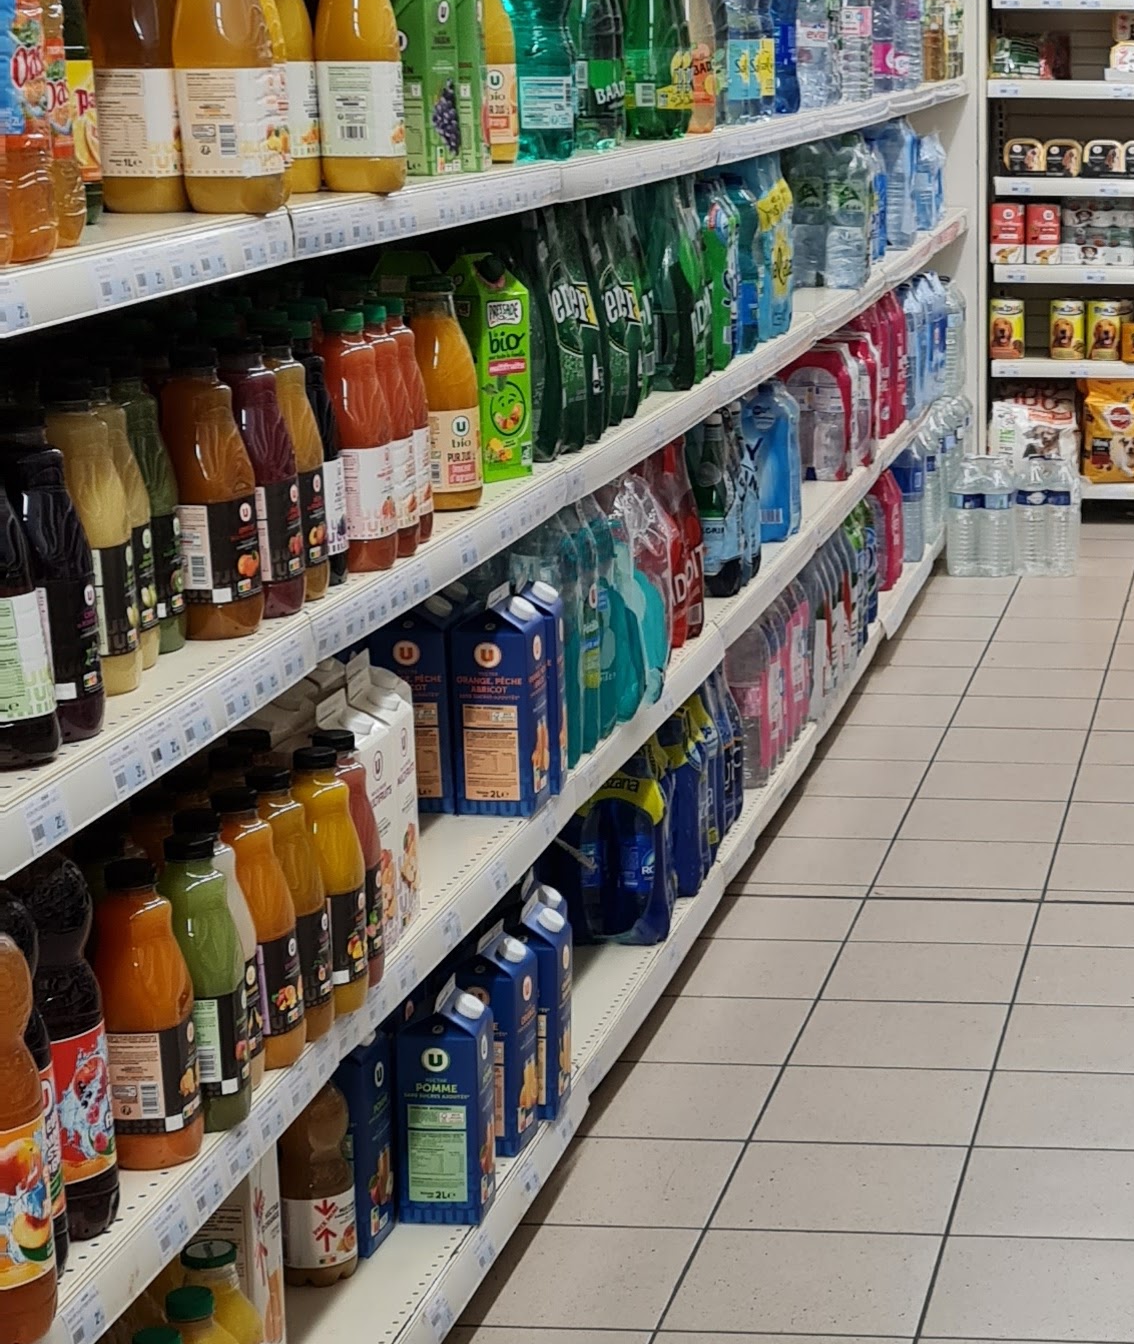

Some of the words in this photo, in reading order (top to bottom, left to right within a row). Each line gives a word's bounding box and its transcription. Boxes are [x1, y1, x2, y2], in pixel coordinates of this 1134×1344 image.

[489, 331, 525, 355] bio
[456, 420, 467, 432] U
[451, 438, 472, 449] bio
[400, 647, 414, 661] U
[480, 649, 494, 663] U
[495, 675, 523, 686] PÊCHE
[471, 685, 509, 695] ABRICOT
[428, 1054, 443, 1066] U
[415, 1082, 458, 1093] POMME
